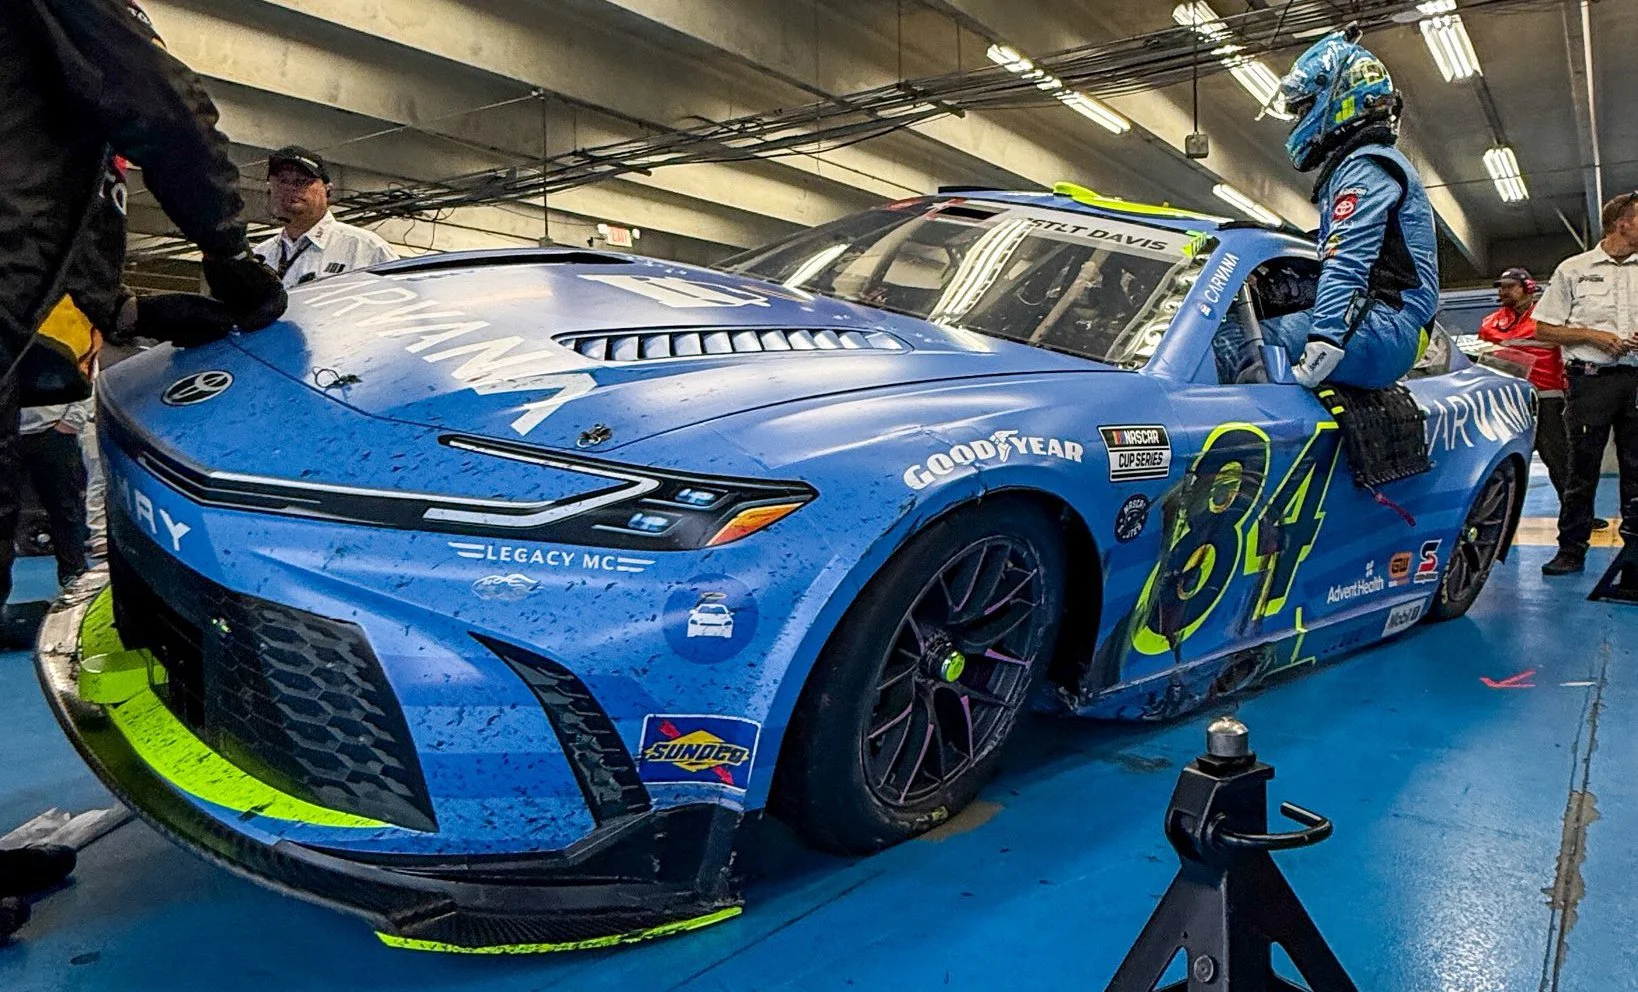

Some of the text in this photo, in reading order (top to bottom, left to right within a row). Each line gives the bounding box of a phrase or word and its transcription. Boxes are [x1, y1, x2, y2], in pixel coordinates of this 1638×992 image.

[1088, 229, 1168, 251] DAVIS
[1204, 252, 1240, 304] CARVANA
[288, 278, 598, 436] ARVANA
[1420, 382, 1533, 457] ARVANA
[1123, 429, 1160, 445] NASCAR
[903, 431, 1084, 490] GOODYEAR
[1118, 451, 1163, 468] CUP SERIES
[1131, 421, 1343, 655] 84
[486, 545, 616, 571] LEGACY MC
[1326, 575, 1384, 604] AdventHealth
[648, 742, 749, 765] SUNOCO
